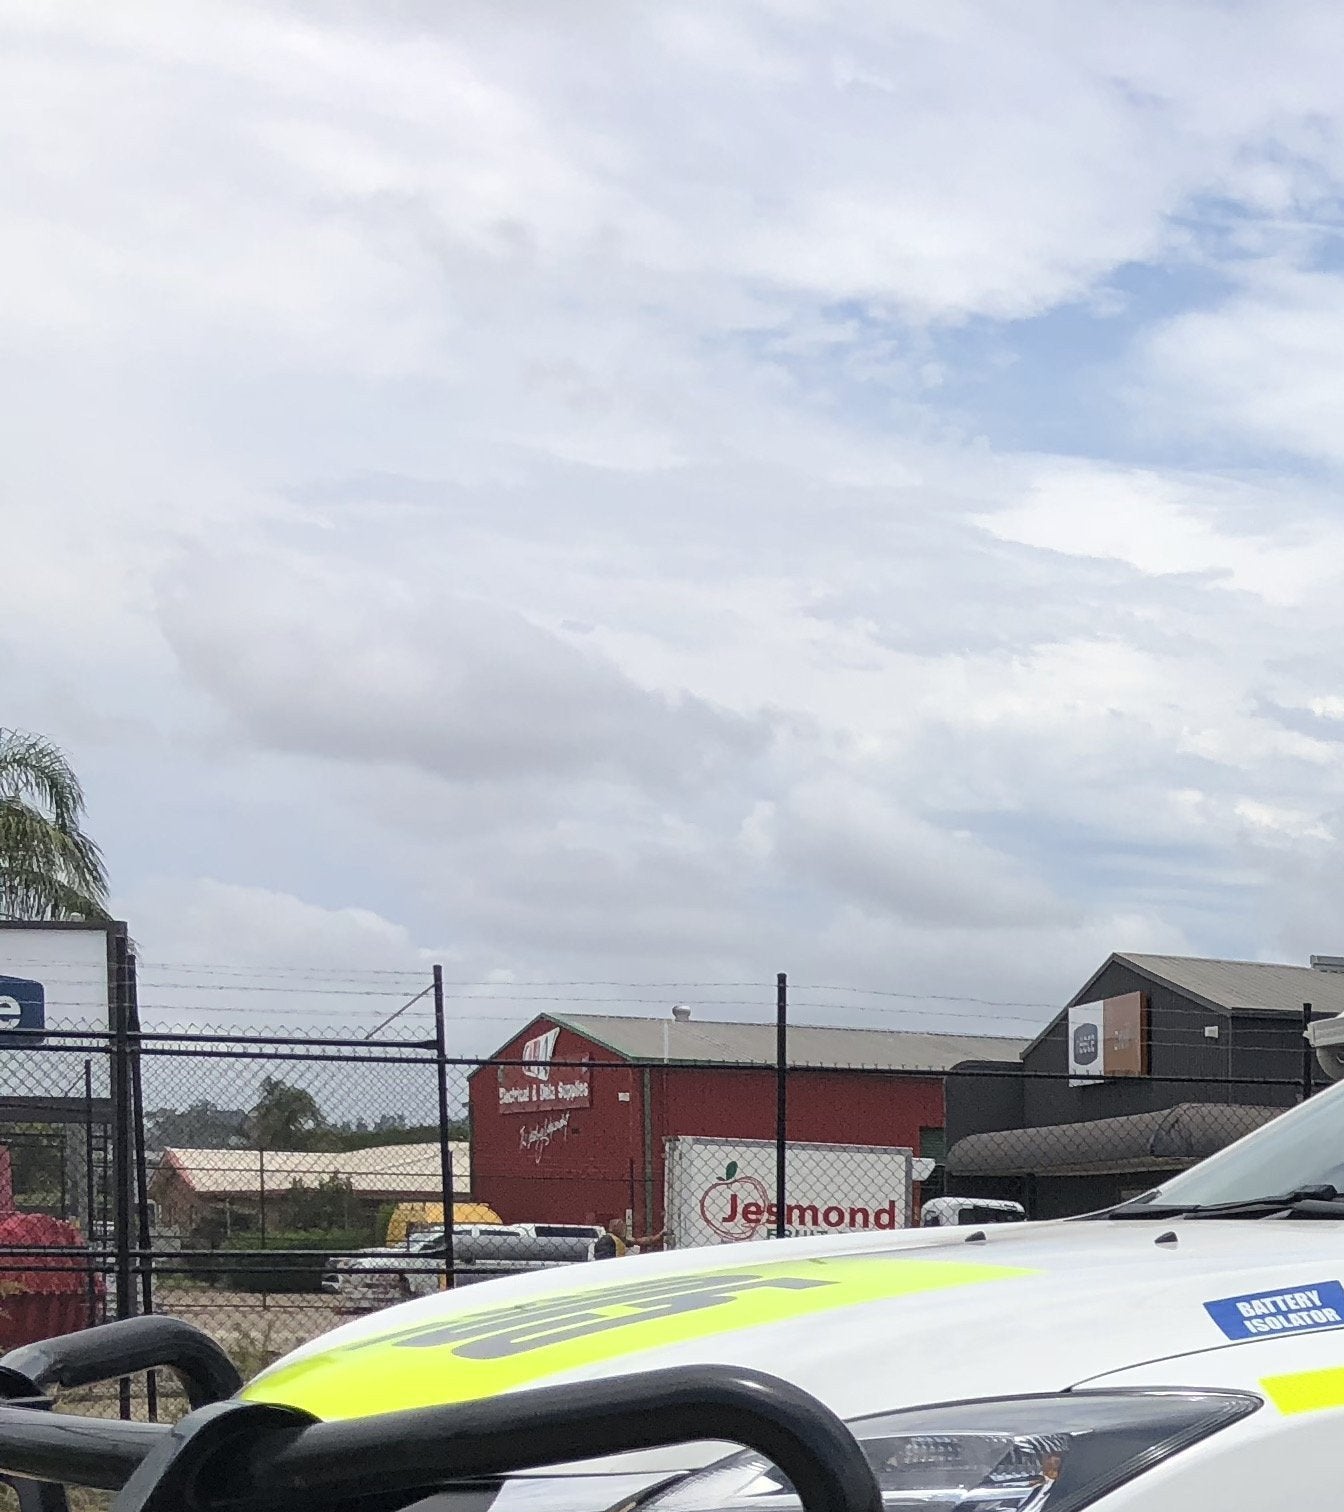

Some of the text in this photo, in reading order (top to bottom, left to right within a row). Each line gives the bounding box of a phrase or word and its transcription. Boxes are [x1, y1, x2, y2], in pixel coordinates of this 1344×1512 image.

[721, 1194, 896, 1230] Jesmond
[1235, 1290, 1323, 1318] BATTERY
[1243, 1308, 1342, 1334] ISOLATOR
